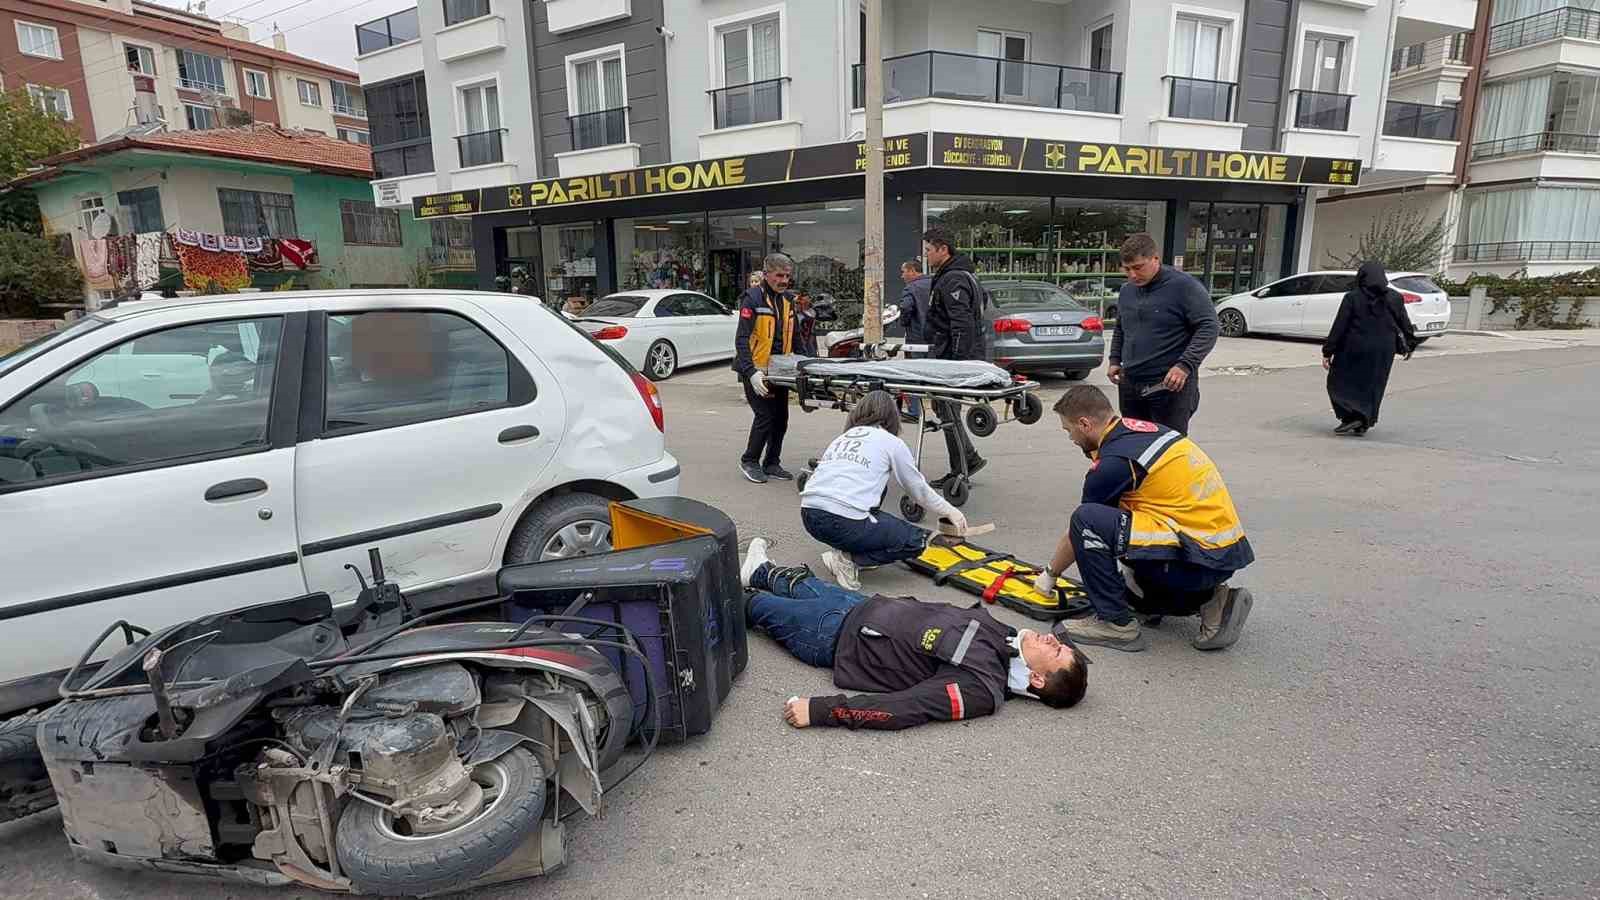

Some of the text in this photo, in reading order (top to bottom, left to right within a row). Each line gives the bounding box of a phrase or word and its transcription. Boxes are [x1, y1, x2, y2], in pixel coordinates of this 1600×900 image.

[896, 138, 909, 151] VE
[954, 136, 963, 149] EV
[856, 153, 912, 170] PEENDE
[1079, 144, 1289, 181] PARILTI HOME
[531, 158, 747, 206] PARILTI HOME
[833, 440, 862, 454] 112
